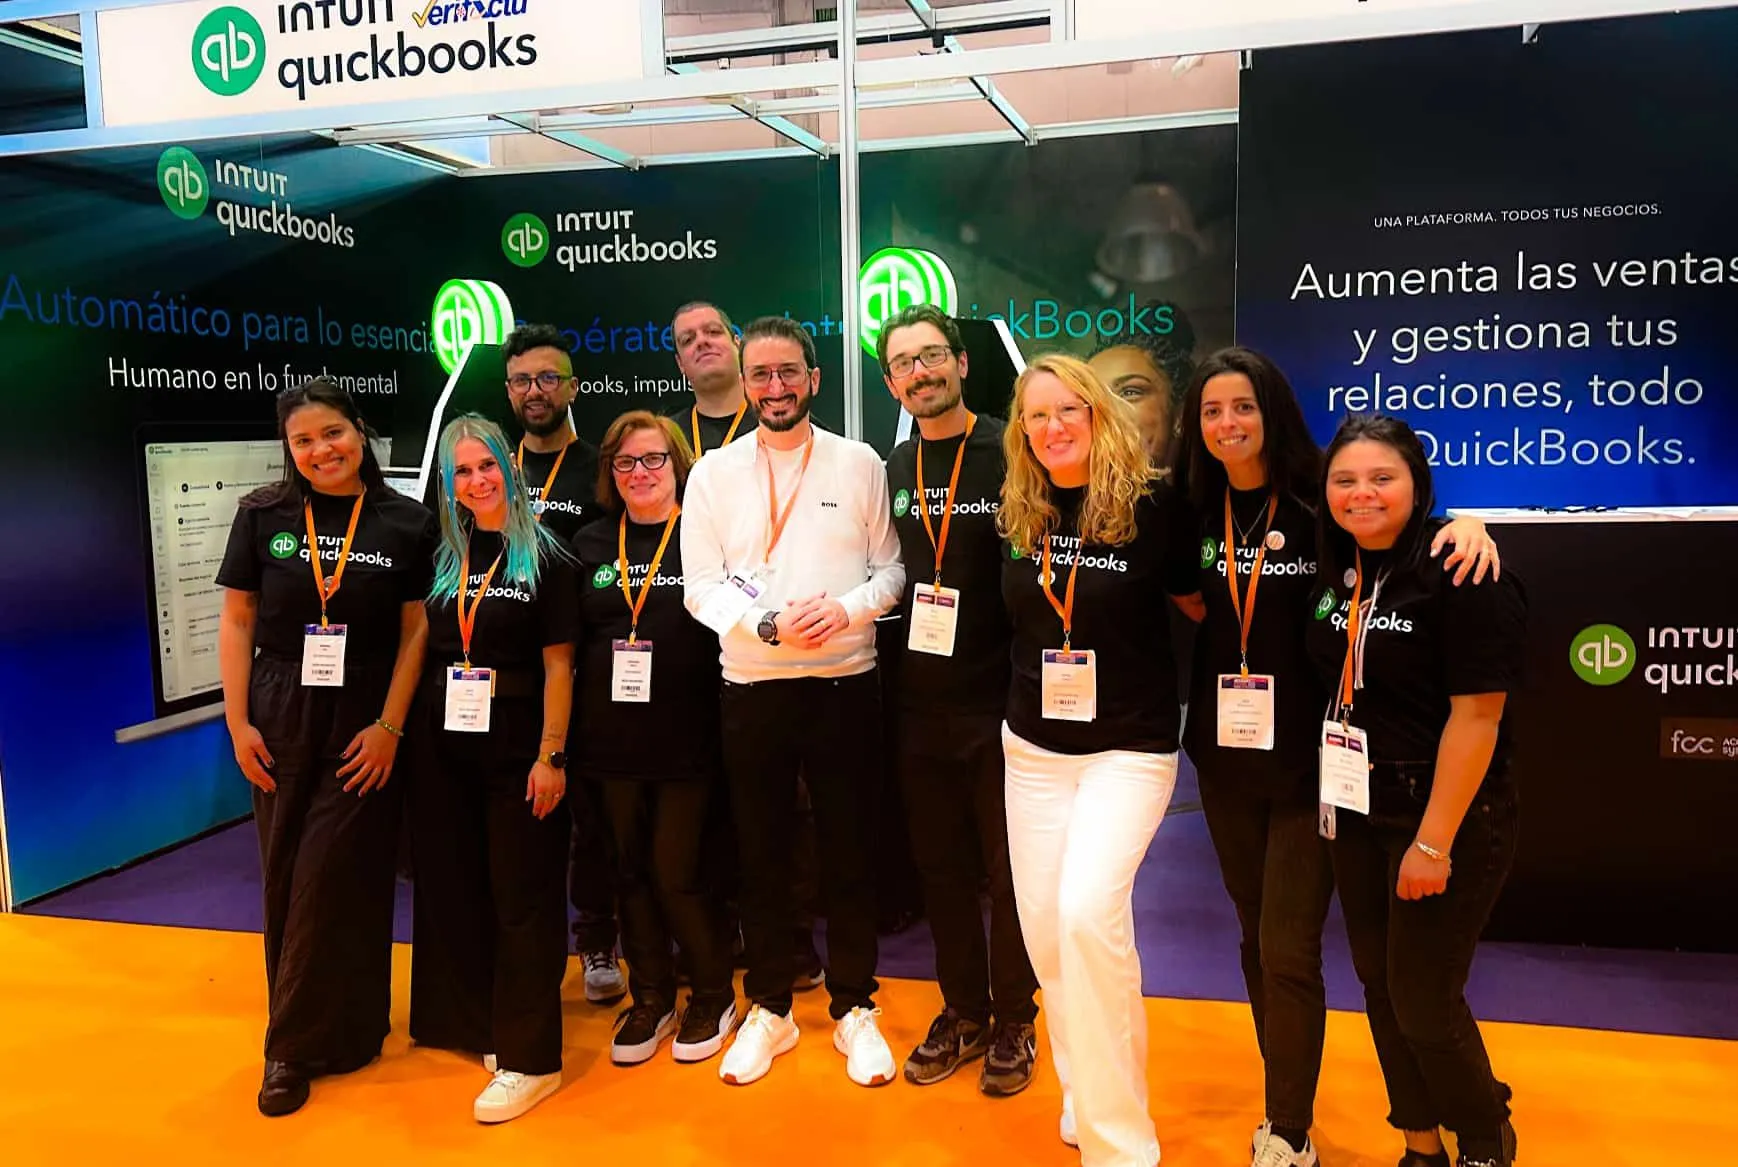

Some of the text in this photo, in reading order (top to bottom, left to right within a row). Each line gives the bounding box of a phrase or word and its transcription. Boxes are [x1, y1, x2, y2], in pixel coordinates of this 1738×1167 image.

[278, 22, 537, 100] quickbooks
[216, 200, 355, 248] quickbooks
[1374, 203, 1662, 228] UNA PLATAFORMA. TODOS TUS NEGOCIOS.
[556, 231, 717, 272] quickbooks
[1290, 261, 1498, 300] Aumenta
[1517, 250, 1577, 291] las
[0, 272, 231, 338] Automático
[243, 311, 309, 350] para
[317, 304, 342, 346] lo
[1352, 314, 1678, 365] y gestiona tus
[108, 356, 217, 389] Humano
[224, 370, 252, 390] en
[258, 362, 278, 391] lo
[1328, 365, 1703, 414] relaciones, todo
[1414, 425, 1696, 467] QuickBooks.
[1649, 627, 1738, 648] INTUI
